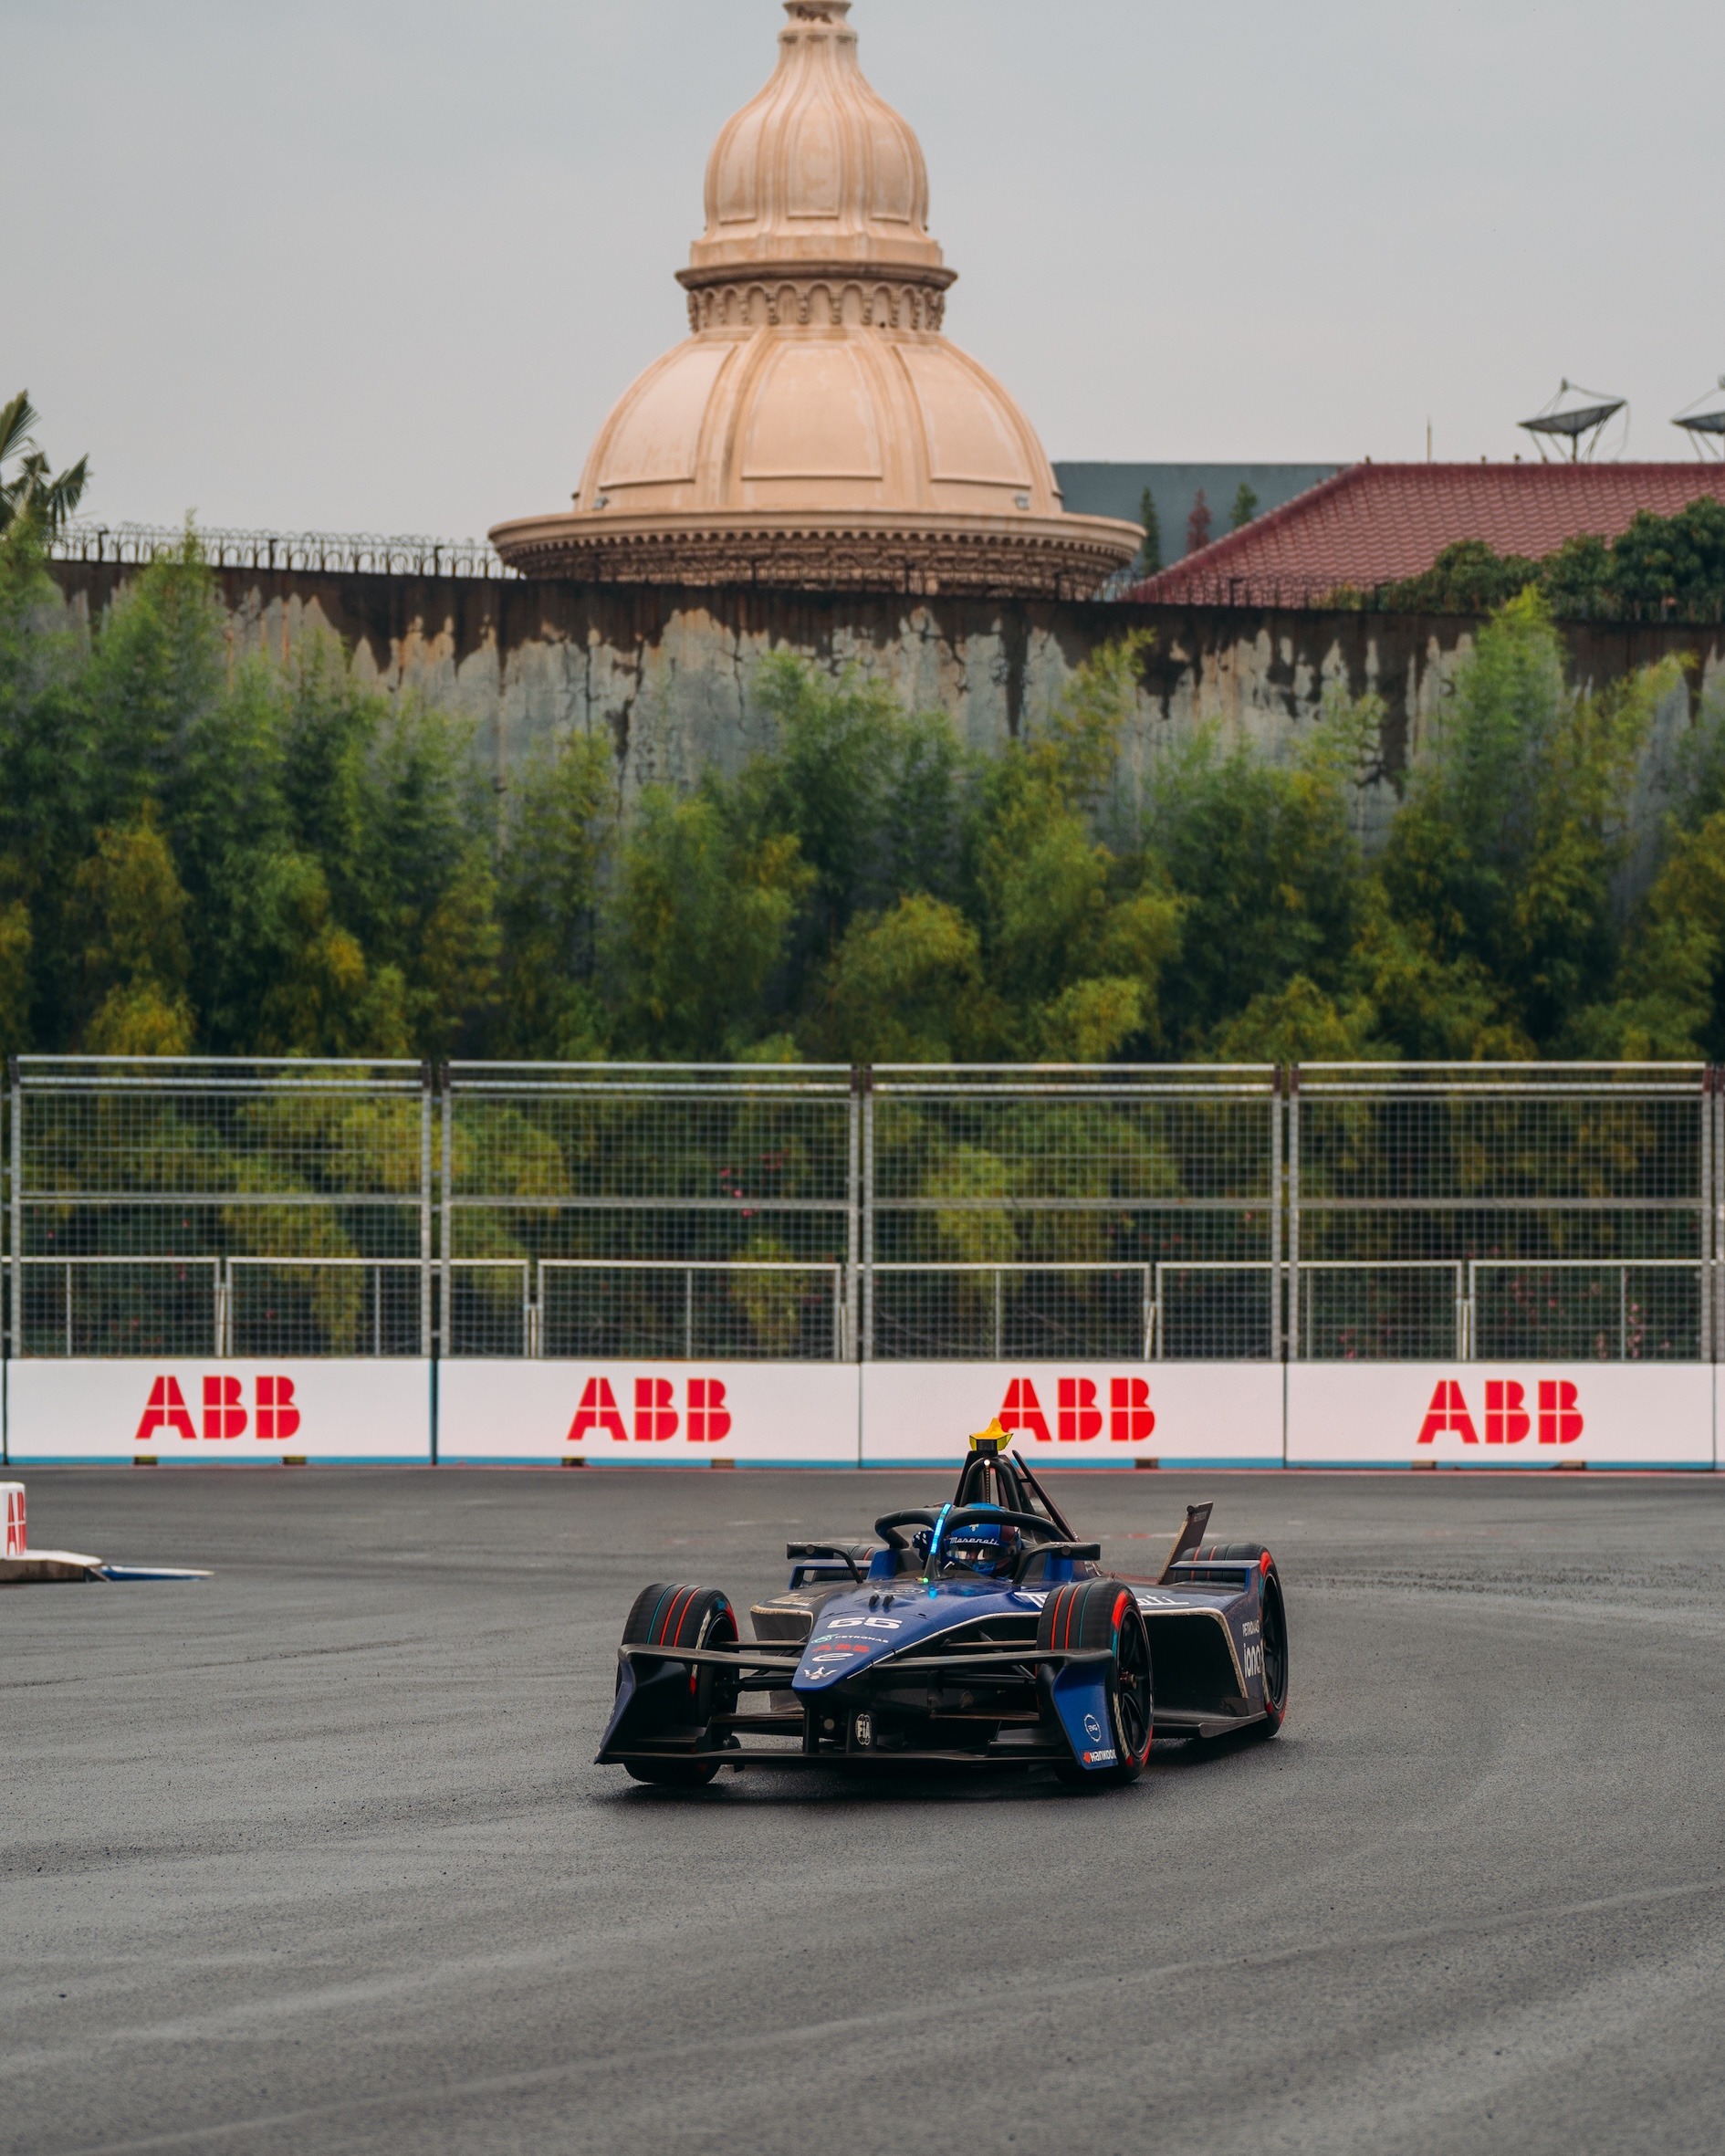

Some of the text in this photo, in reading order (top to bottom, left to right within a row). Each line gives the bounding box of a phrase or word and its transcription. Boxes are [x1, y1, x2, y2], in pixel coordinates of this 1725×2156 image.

[135, 1376, 300, 1439] ABB
[568, 1377, 732, 1441] ABB
[998, 1377, 1155, 1441] ABB
[1417, 1380, 1584, 1444] ABB
[949, 1536, 999, 1546] Maserati
[827, 1617, 903, 1629] 55
[834, 1635, 889, 1643] PETRONAS
[811, 1644, 870, 1653] ABB
